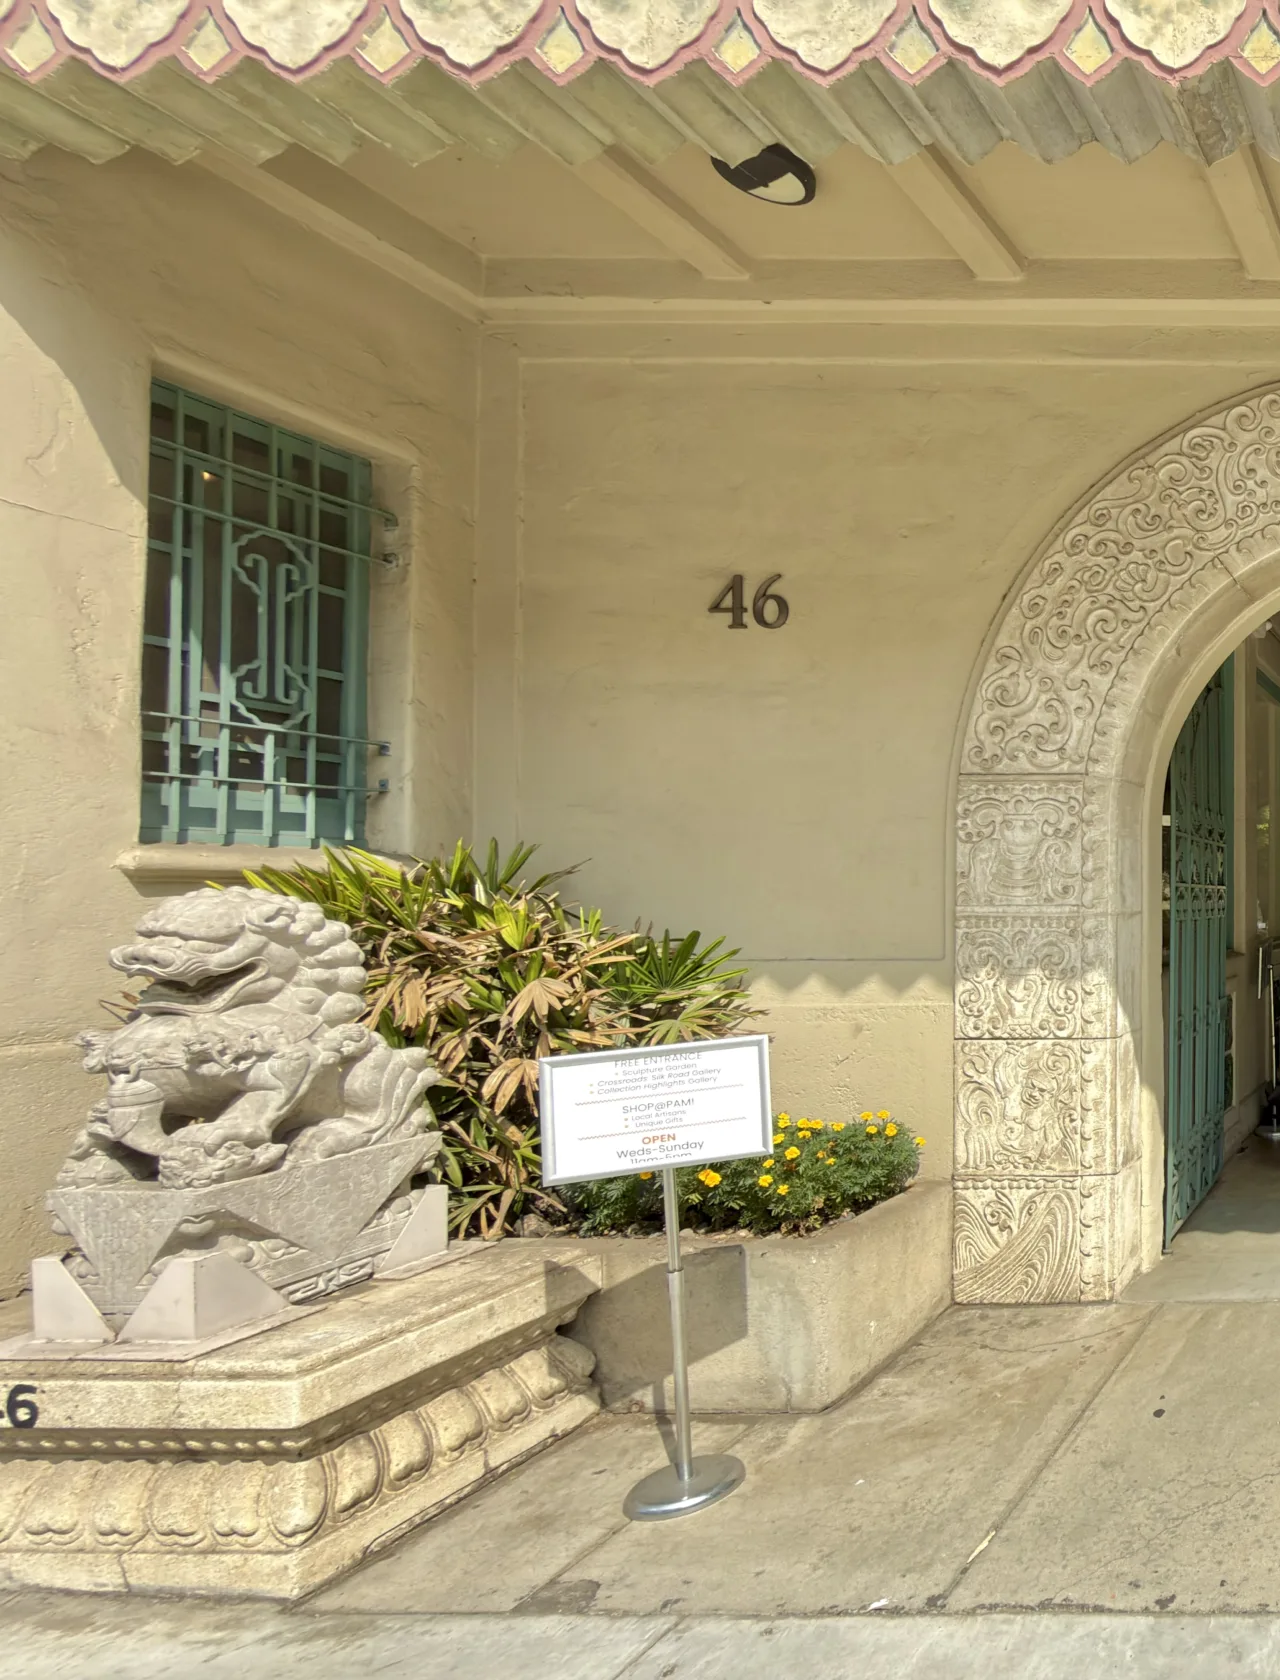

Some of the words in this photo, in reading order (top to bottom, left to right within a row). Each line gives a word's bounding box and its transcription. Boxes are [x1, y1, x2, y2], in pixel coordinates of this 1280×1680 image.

[708, 574, 789, 629] 46
[615, 1059, 640, 1069] FREE
[644, 1052, 702, 1066] ENTRANCE
[622, 1066, 663, 1077] Sculpture
[665, 1063, 697, 1072] Garden
[651, 1073, 664, 1081] Silk
[667, 1071, 690, 1079] Road
[692, 1067, 721, 1077] Gallery
[597, 1085, 641, 1095] Collection
[644, 1079, 685, 1090] Highlights
[688, 1076, 718, 1086] Gallery
[622, 1098, 694, 1114] SHOP@PAM!
[631, 1113, 653, 1122] Local
[654, 1109, 687, 1118] Artisans
[635, 1120, 663, 1129] Unique
[665, 1116, 683, 1125] Gifts
[642, 1133, 676, 1145] OPEN
[616, 1141, 704, 1159] Weds-Sunday
[0, 1384, 39, 1428] 6
